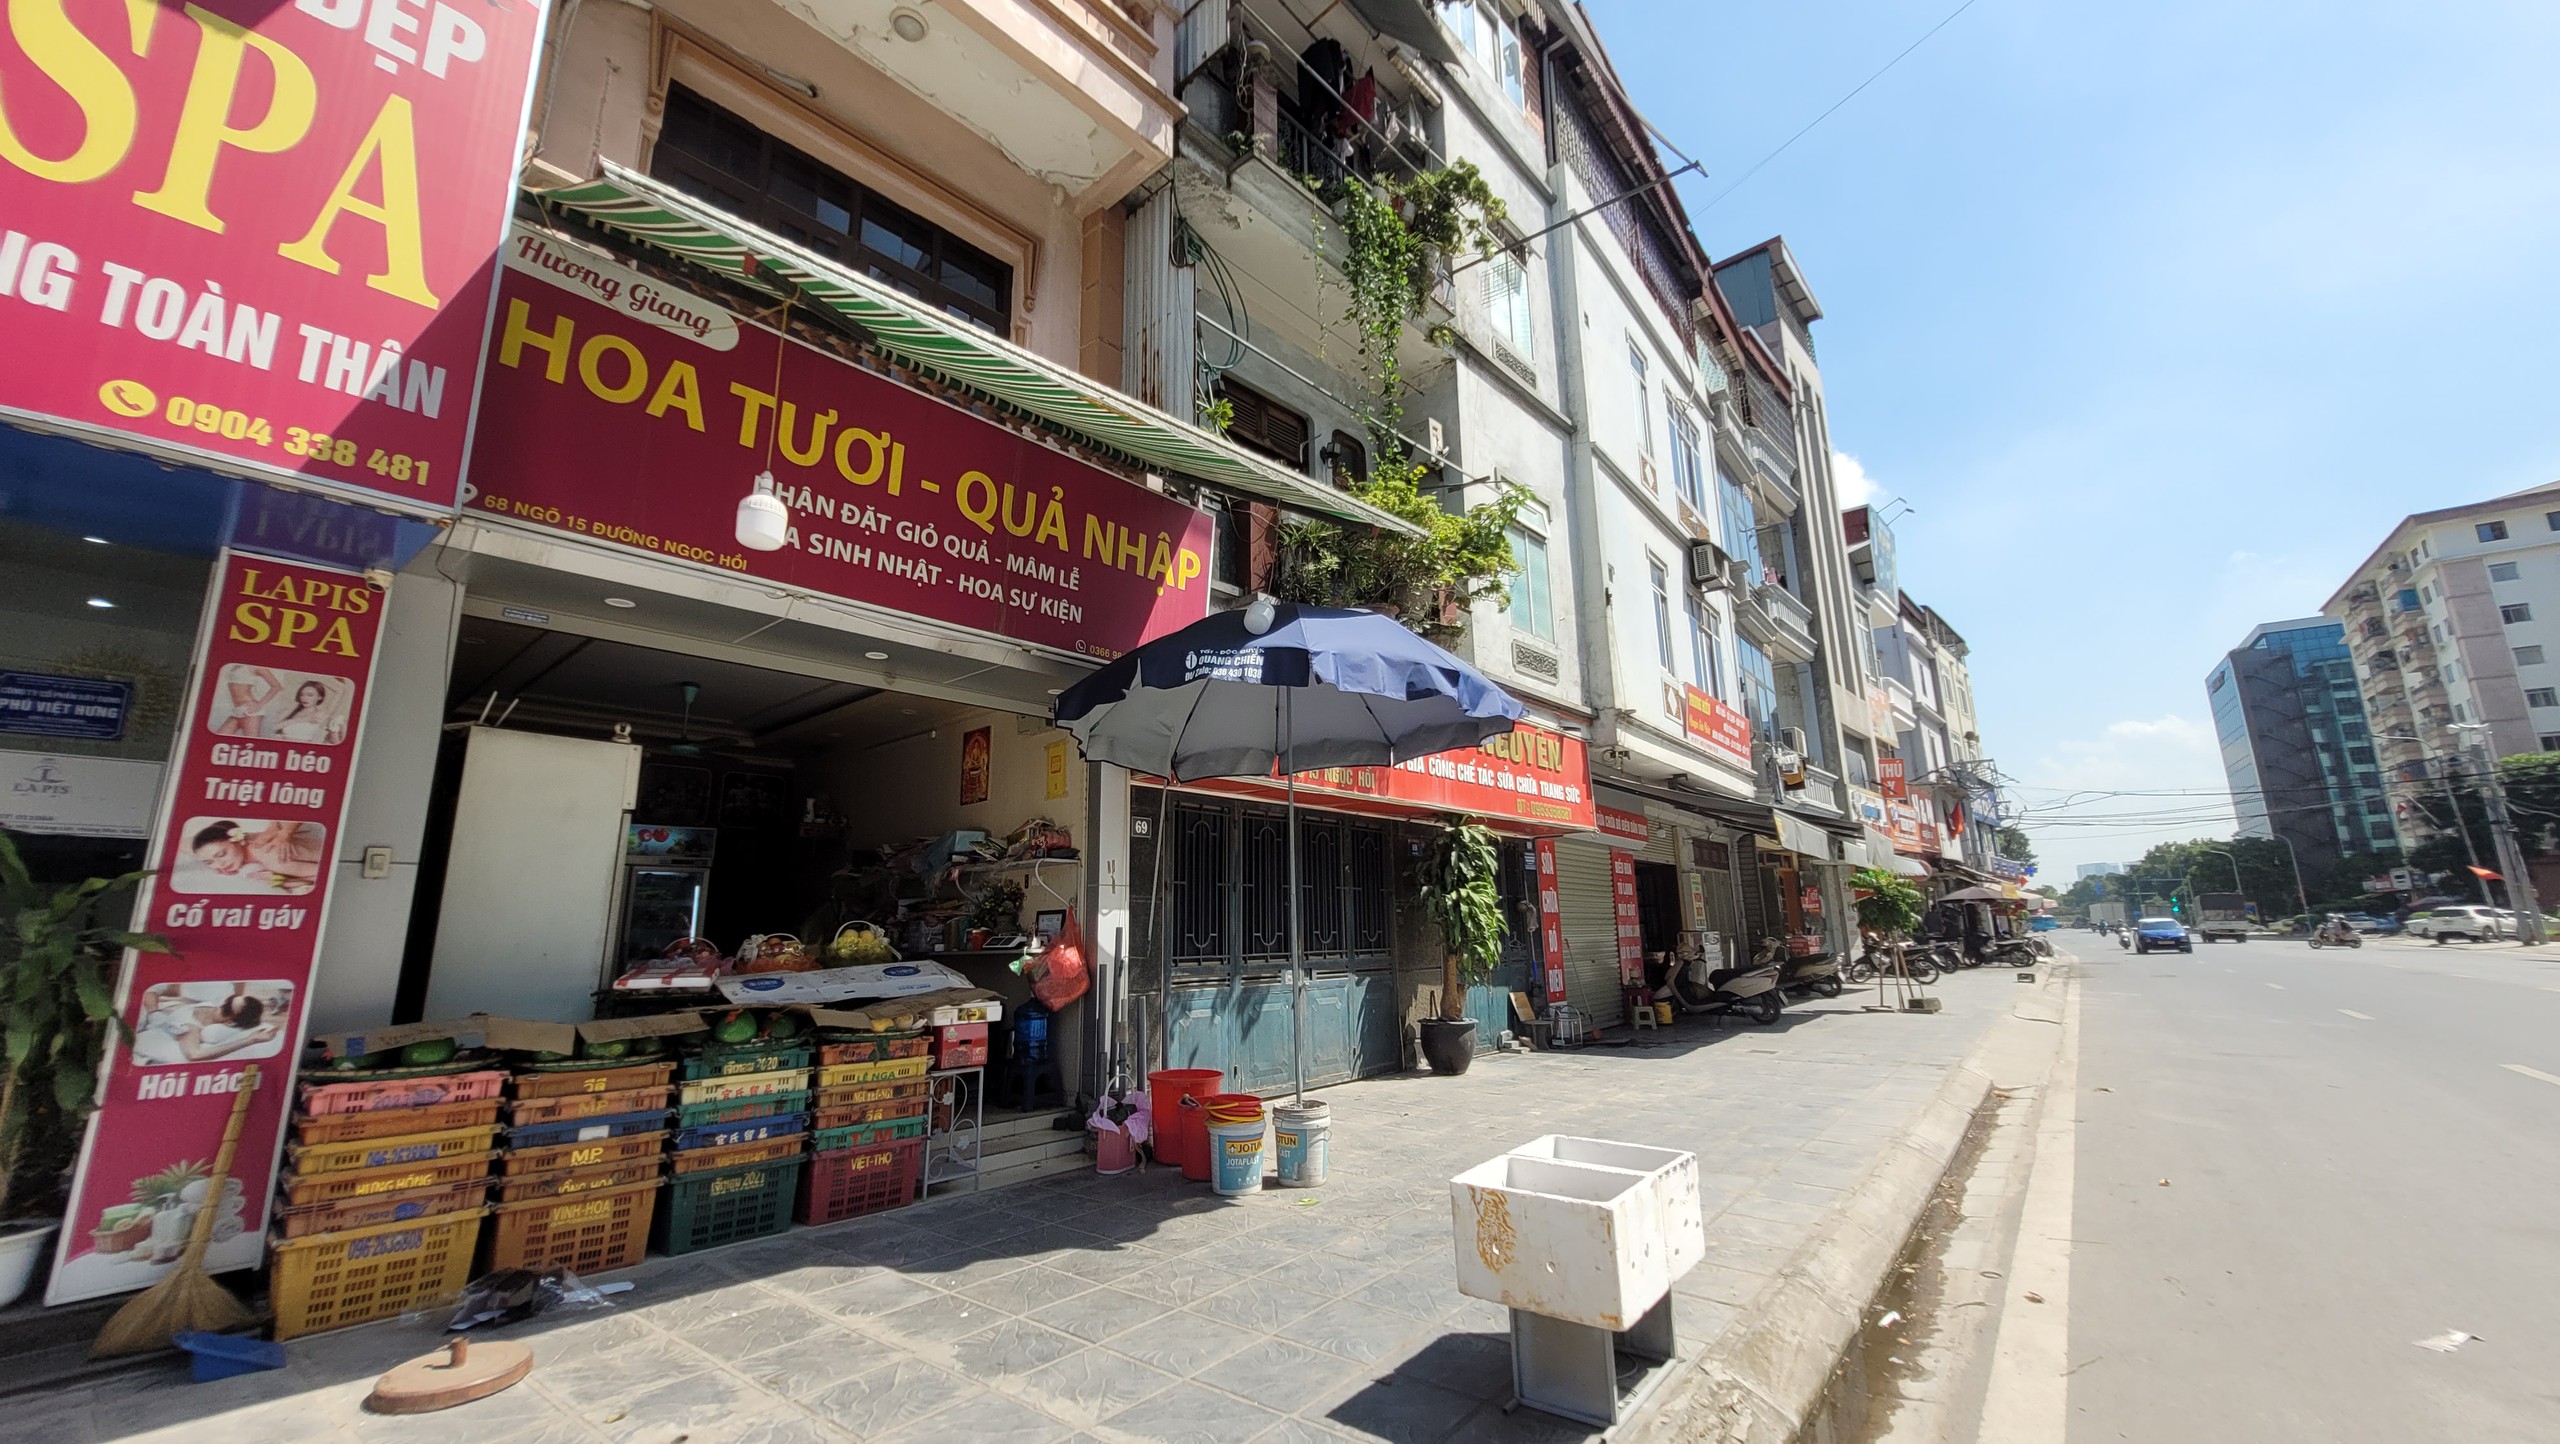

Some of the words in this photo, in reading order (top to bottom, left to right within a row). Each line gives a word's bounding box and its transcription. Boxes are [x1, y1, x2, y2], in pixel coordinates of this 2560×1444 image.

[0, 0, 441, 310] SPA
[517, 235, 622, 299] Hương
[629, 283, 713, 338] Giang
[100, 260, 281, 371] TOÀN
[298, 324, 446, 419] THÂN
[166, 396, 272, 446] 0904
[283, 427, 357, 467] 338
[367, 448, 430, 486] 481
[499, 297, 705, 432] HOA
[729, 382, 906, 497] TƯƠI
[920, 480, 941, 494] -
[956, 470, 1069, 553] QUẢ
[1083, 514, 1202, 597] NHẬP
[484, 495, 509, 511] 68
[515, 500, 561, 524] NGÕ
[567, 515, 587, 531] 15
[592, 522, 659, 550] ĐƯỜNG
[663, 538, 714, 565] NGỌC
[719, 547, 748, 572] HỒI
[753, 475, 836, 517] HẬN
[841, 503, 892, 536] ĐẶT
[896, 521, 939, 549] GIỎ
[943, 535, 990, 565] QUẢ
[1005, 553, 1055, 585] MÂM
[1059, 567, 1080, 592] LỄ
[240, 569, 370, 614] LAPIS
[807, 533, 872, 568] SINH
[876, 551, 942, 587] NHẬT
[958, 575, 1004, 602] HOA
[1009, 589, 1039, 616] SỰ
[1040, 598, 1083, 625] KIỆN
[229, 602, 361, 658] SPA
[1089, 644, 1110, 659] 0366
[1112, 649, 1127, 660] 98
[1199, 655, 1232, 665] QUANG
[36, 700, 72, 716] VIỆT
[210, 743, 278, 772] Giảm
[285, 749, 331, 774] béo
[1428, 756, 1455, 780] CÔNG
[1457, 759, 1475, 784] CHẾ
[1476, 764, 1494, 787] TÁC
[1497, 766, 1514, 791] SỬA
[1516, 773, 1538, 795] CHỮA
[1540, 781, 1564, 800] TRANG
[1565, 784, 1580, 803] SỨC
[1880, 760, 1902, 777] THÚ
[204, 776, 264, 807] Triệt
[269, 779, 325, 809] lông
[1135, 820, 1148, 833] 69
[167, 899, 211, 928] Cổ
[211, 904, 254, 928] vai
[258, 904, 306, 931] gáy
[138, 1071, 186, 1101] Hôi
[571, 1147, 604, 1164] MP
